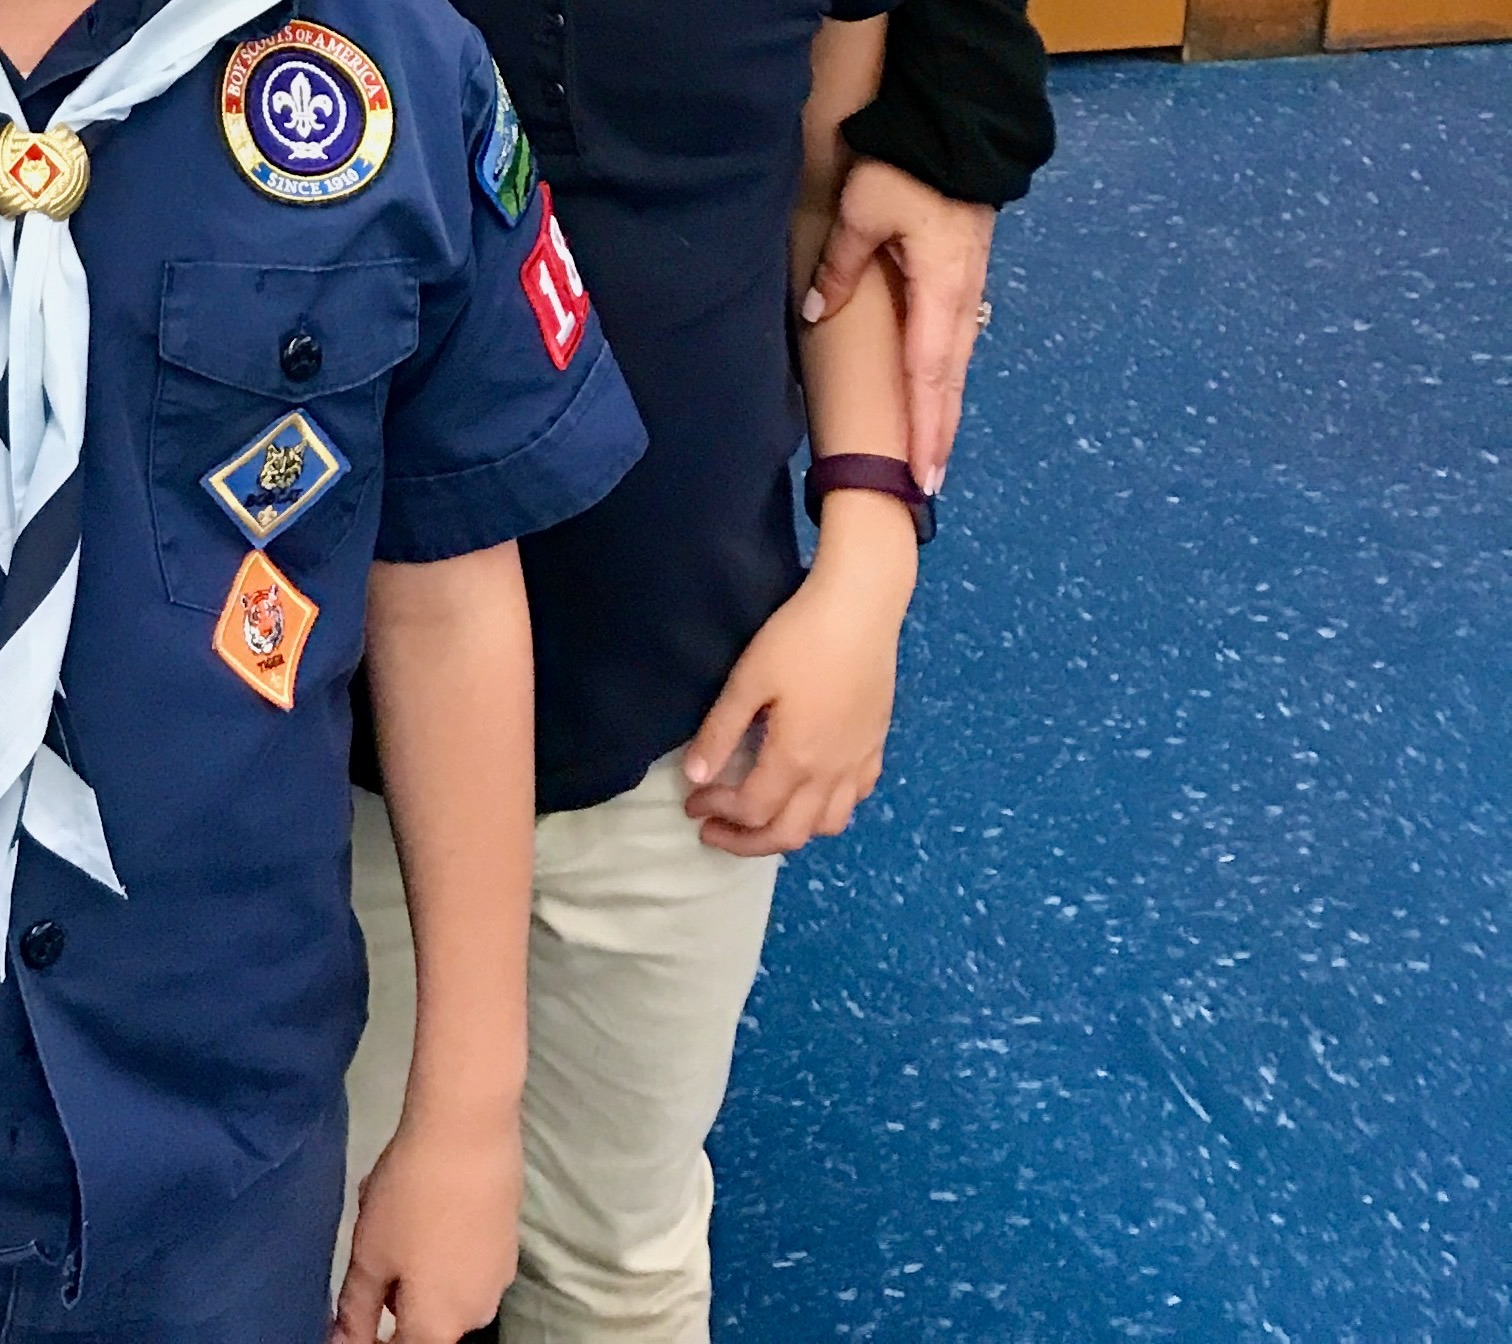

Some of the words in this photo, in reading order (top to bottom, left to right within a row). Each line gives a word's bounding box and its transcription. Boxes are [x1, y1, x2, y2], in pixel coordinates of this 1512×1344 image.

[227, 57, 247, 97] BOY
[295, 28, 313, 44] OF
[313, 32, 382, 99] AMERICA
[265, 173, 322, 197] SINCE
[324, 168, 361, 196] 1910
